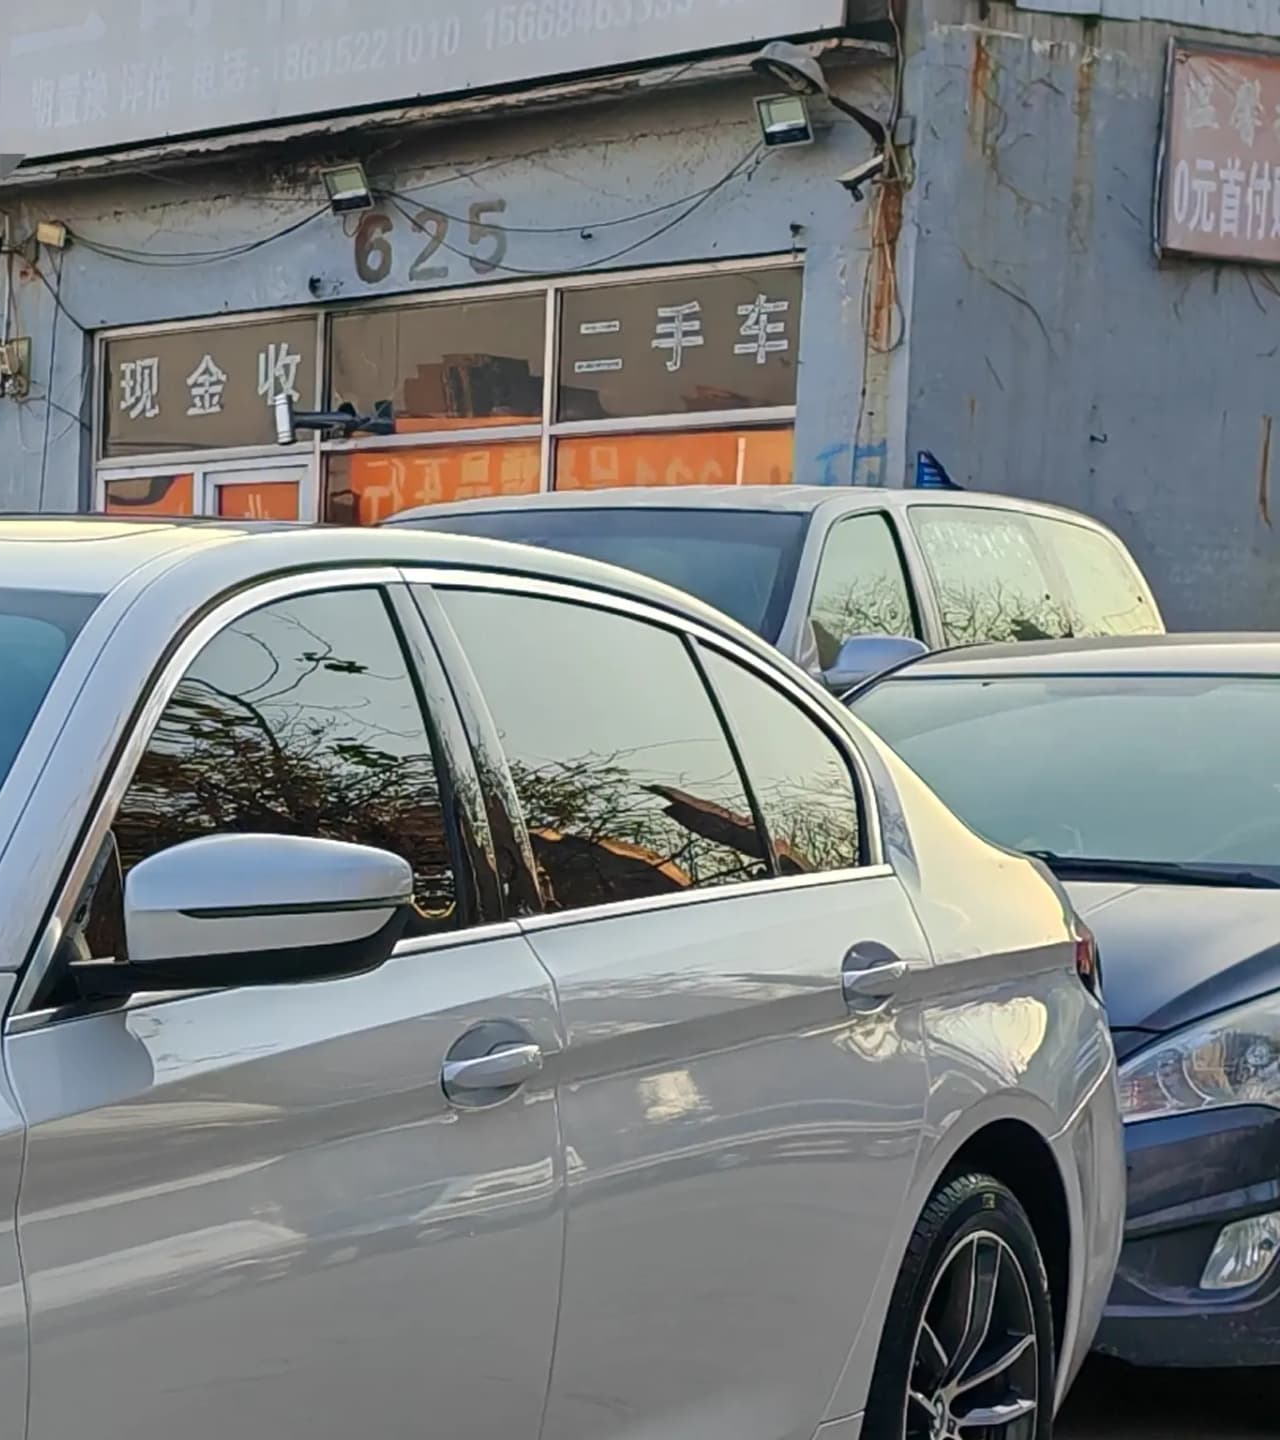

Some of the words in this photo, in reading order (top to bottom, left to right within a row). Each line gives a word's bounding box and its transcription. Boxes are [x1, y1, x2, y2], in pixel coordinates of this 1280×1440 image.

[355, 197, 508, 285] 625
[120, 343, 301, 419] 现金收
[574, 294, 789, 372] 二手车
